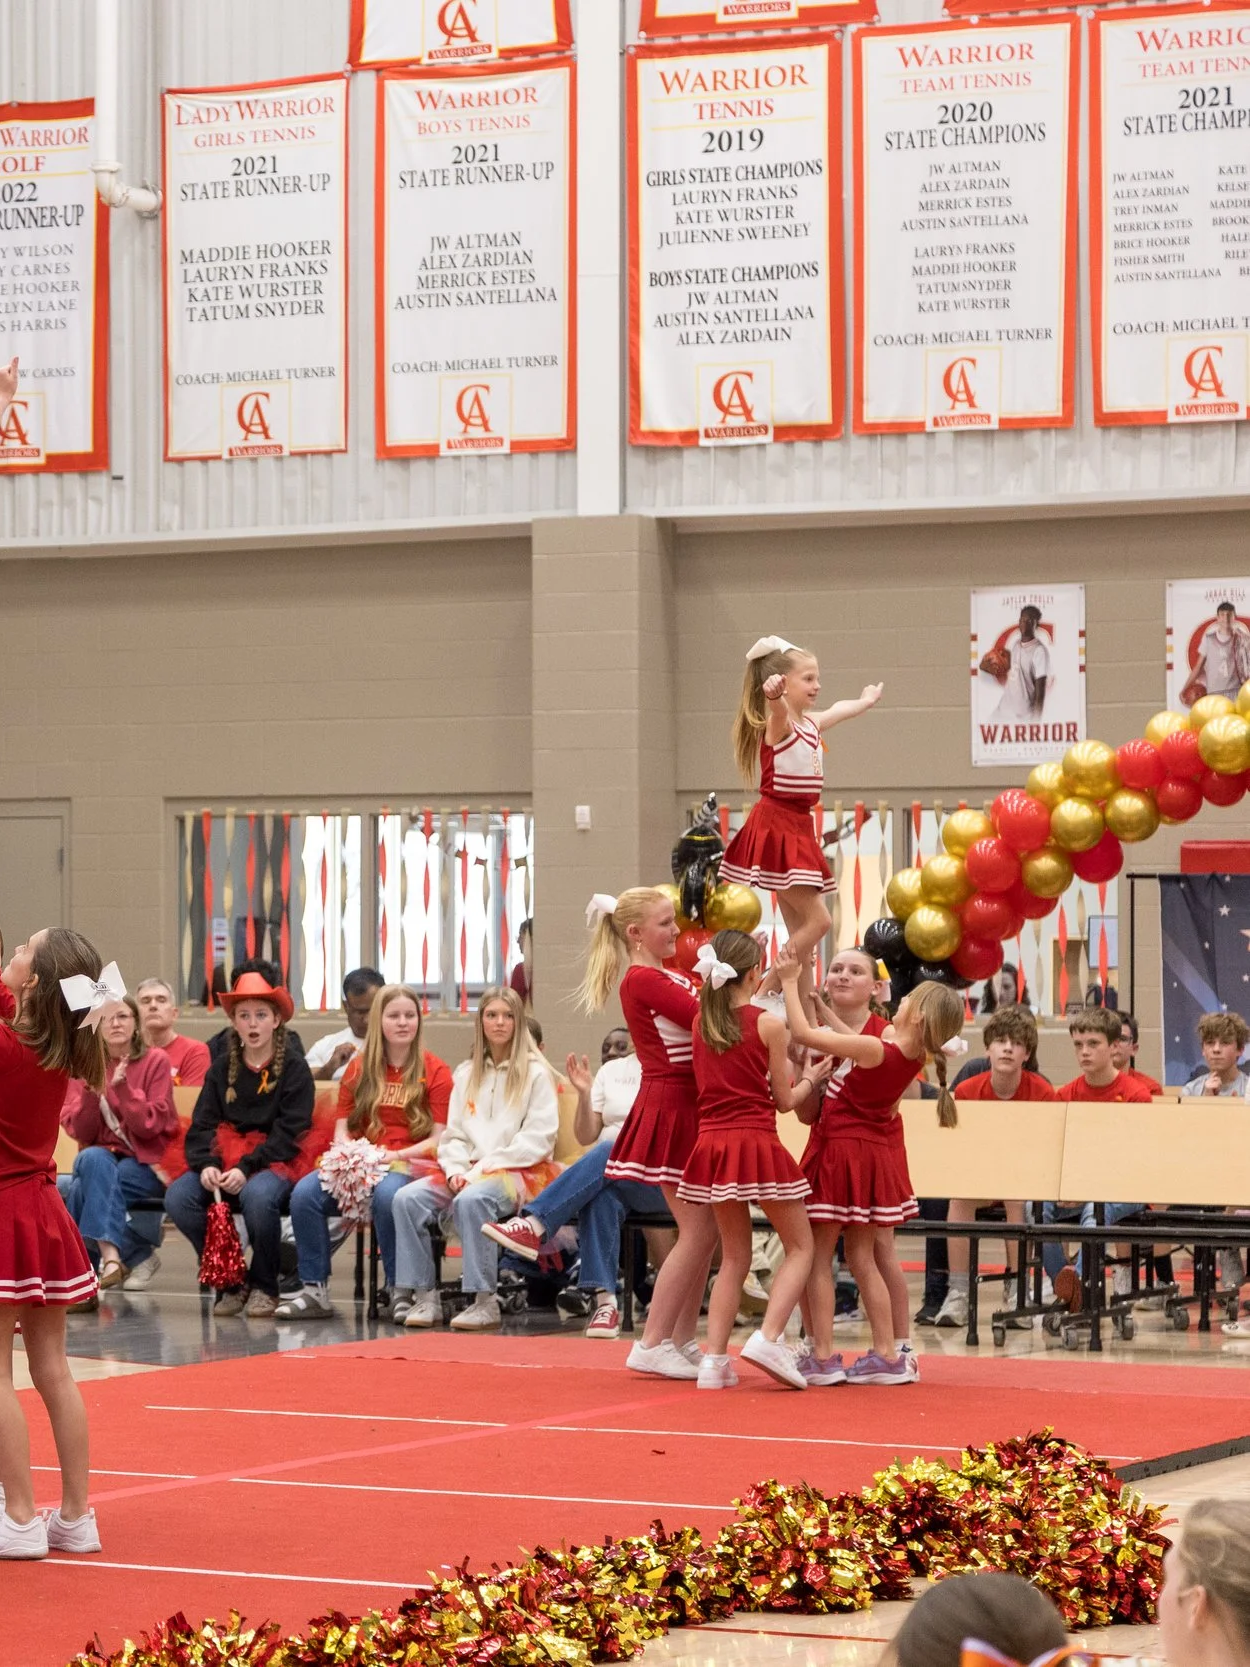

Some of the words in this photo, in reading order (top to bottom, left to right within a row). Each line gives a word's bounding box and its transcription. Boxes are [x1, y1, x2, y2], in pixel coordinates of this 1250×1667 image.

[725, 2, 789, 15] WARRIORS
[432, 45, 490, 59] WARRIORS
[896, 42, 1036, 69] WARRIOR
[659, 64, 809, 95] WARRIOR
[1138, 60, 1195, 78] TEAM
[900, 75, 955, 94] TEAM
[959, 71, 1032, 90] TENNIS
[415, 86, 539, 112] WARRIOR
[1178, 85, 1233, 109] 2021
[175, 103, 233, 126] LADY
[234, 96, 335, 121] WARRIOR
[693, 98, 775, 120] TENNIS
[937, 101, 993, 125] 2020
[417, 119, 462, 135] BOYS
[466, 113, 531, 132] TENNIS
[1123, 113, 1177, 137] STATE
[194, 131, 246, 149] GIRLS
[250, 125, 316, 144] TENNIS
[702, 128, 765, 154] 2019
[885, 128, 937, 152] STATE
[941, 121, 1046, 147] CHAMPIONS
[451, 143, 500, 164] 2021
[231, 155, 278, 177] 2021
[399, 168, 450, 189] STATE
[454, 161, 555, 186] RUNNER-UP
[646, 169, 685, 187] GIRLS
[688, 165, 732, 184] STATE
[735, 159, 823, 182] CHAMPIONS
[928, 164, 945, 176] JW
[949, 159, 1001, 175] ALTMAN
[1129, 169, 1174, 182] ALTMAN
[1218, 165, 1247, 176] KATE
[180, 180, 230, 202] STATE
[234, 172, 331, 198] RUNNER-UP
[672, 188, 732, 206] LAURYN
[736, 184, 798, 203] FRANKS
[920, 181, 951, 194] ALEX
[1113, 188, 1139, 200] ALEX
[918, 197, 973, 212] MERRICK
[976, 195, 1012, 208] ESTES
[1114, 205, 1139, 217] TREY
[1142, 202, 1179, 215] INMAN
[675, 209, 713, 225] KATE
[717, 204, 795, 223] WURSTER
[900, 217, 947, 232] AUSTIN
[949, 213, 1029, 229] SANTELLANA
[657, 229, 734, 249] JULIENNE
[737, 222, 811, 241] SWEENEY
[1113, 221, 1161, 234] MERRICK
[1163, 219, 1193, 230] ESTES
[13, 243, 75, 259] WILSON
[180, 245, 251, 265] MADDIE
[256, 239, 331, 259] HOOKER
[430, 235, 451, 253] JW
[455, 231, 522, 250] ALTMAN
[914, 245, 963, 259] LAURYN
[965, 242, 1016, 256] FRANKS
[1113, 238, 1143, 250] BRICE
[1146, 235, 1191, 249] HOOKER
[11, 262, 71, 277] CARNES
[418, 254, 458, 271] ALEX
[461, 249, 534, 268] ZARDIAN
[912, 263, 960, 278] MADDIE
[963, 260, 1017, 275] HOOKER
[1113, 255, 1150, 267] FISHER
[1152, 253, 1185, 265] SMITH
[183, 264, 254, 284] LAURYN
[259, 259, 328, 279] FRANKS
[416, 271, 487, 290] MERRICK
[491, 268, 536, 286] ESTES
[649, 270, 683, 288] BOYS
[684, 267, 728, 285] STATE
[731, 261, 819, 282] CHAMPIONS
[1113, 271, 1152, 284] AUSTIN
[1154, 267, 1222, 281] SANTELLANA
[12, 280, 81, 296] HOOKER
[188, 285, 234, 303] KATE
[238, 279, 324, 300] WURSTER
[916, 281, 960, 296] TATUM
[961, 278, 1012, 292] SNYDER
[37, 298, 78, 312] LANE
[394, 292, 452, 310] AUSTIN
[455, 287, 558, 307] SANTELLANA
[686, 291, 710, 309] JW
[713, 288, 779, 305] ALTMAN
[917, 300, 950, 314] KATE
[953, 297, 1010, 312] WURSTER
[185, 304, 250, 322] TATUM
[255, 299, 325, 318] SNYDER
[654, 311, 709, 328] AUSTIN
[713, 305, 815, 325] SANTELLANA
[11, 317, 68, 332] HARRIS
[1112, 320, 1169, 336] COACH:
[1172, 316, 1239, 332] MICHAEL
[676, 331, 715, 346] ALEX
[719, 326, 792, 344] ZARDAIN
[873, 333, 928, 348] COACH:
[931, 330, 992, 345] MICHAEL
[996, 327, 1052, 342] TURNER
[32, 366, 76, 379] CARNES
[392, 360, 442, 374] COACH:
[444, 357, 502, 371] MICHAEL
[506, 355, 559, 368] TURNER
[175, 372, 224, 386] COACH:
[226, 369, 283, 383] MICHAEL
[285, 366, 336, 380] TURNER
[706, 426, 766, 438] WARRIORS
[979, 722, 1078, 744] WARRIOR
